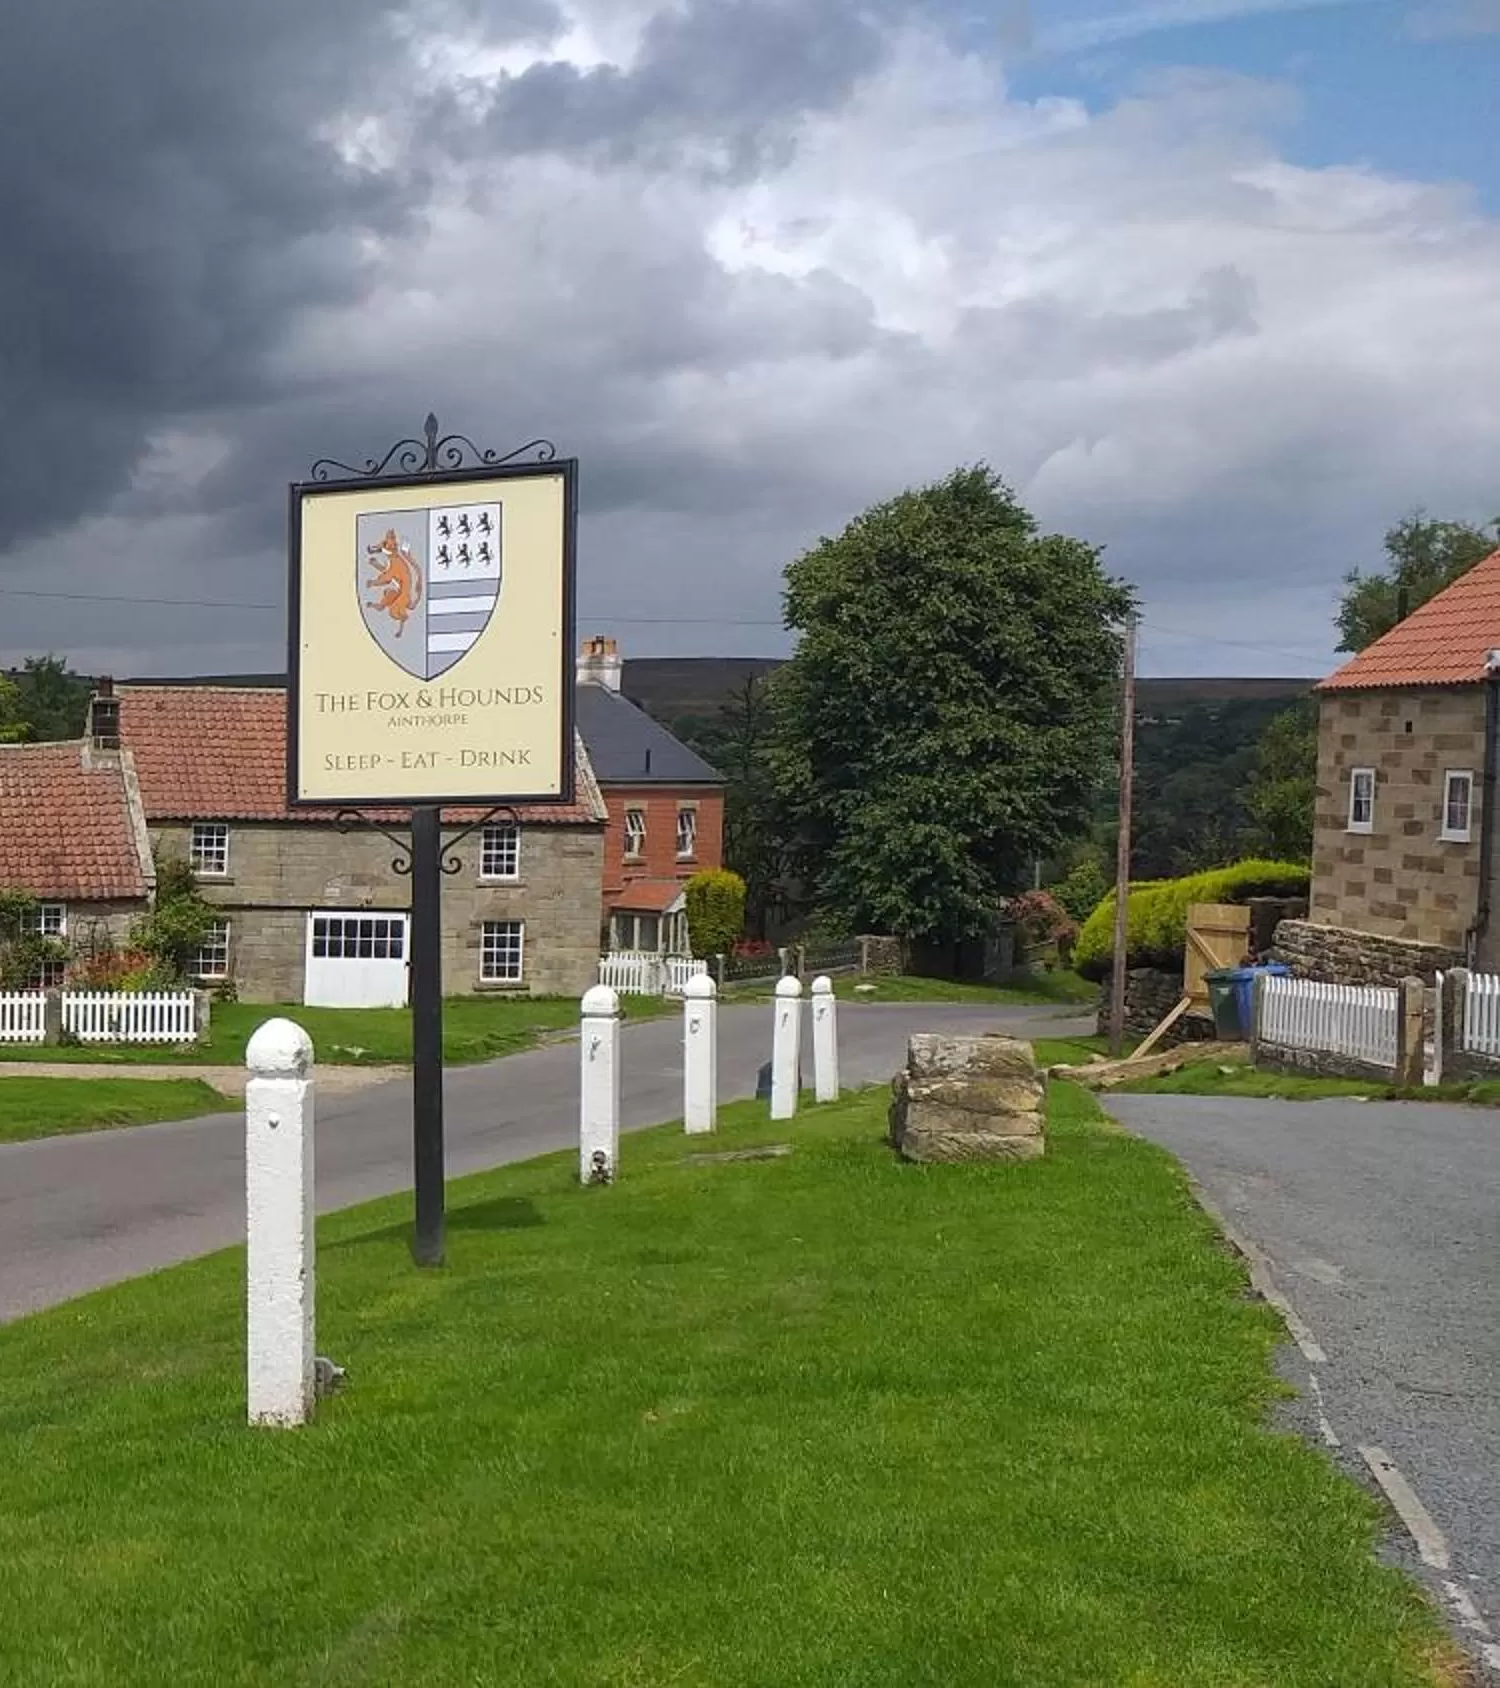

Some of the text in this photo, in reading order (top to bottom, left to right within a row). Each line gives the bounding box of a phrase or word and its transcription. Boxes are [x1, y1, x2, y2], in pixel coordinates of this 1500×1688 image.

[315, 685, 544, 712] THE FOX & HOUNDS
[387, 714, 469, 727] AINTHORPE
[325, 753, 381, 771] SLEEP
[401, 751, 440, 769] EAT
[460, 749, 532, 767] DRINK
